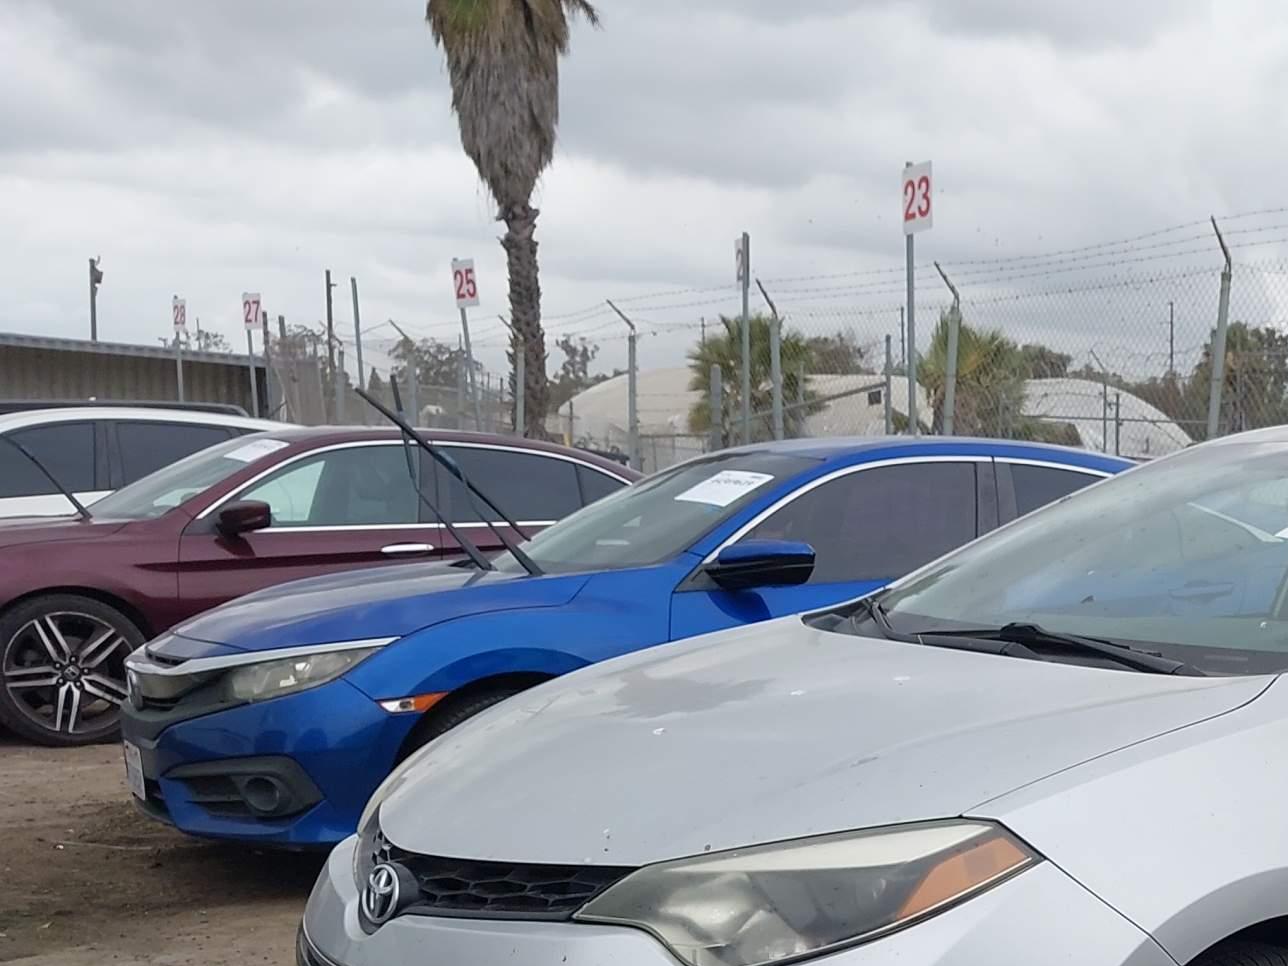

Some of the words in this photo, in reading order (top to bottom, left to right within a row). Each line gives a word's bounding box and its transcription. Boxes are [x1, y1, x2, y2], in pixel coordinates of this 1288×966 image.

[903, 175, 931, 222] 23
[454, 268, 477, 300] 25
[173, 303, 186, 325] 28
[243, 300, 261, 324] 27
